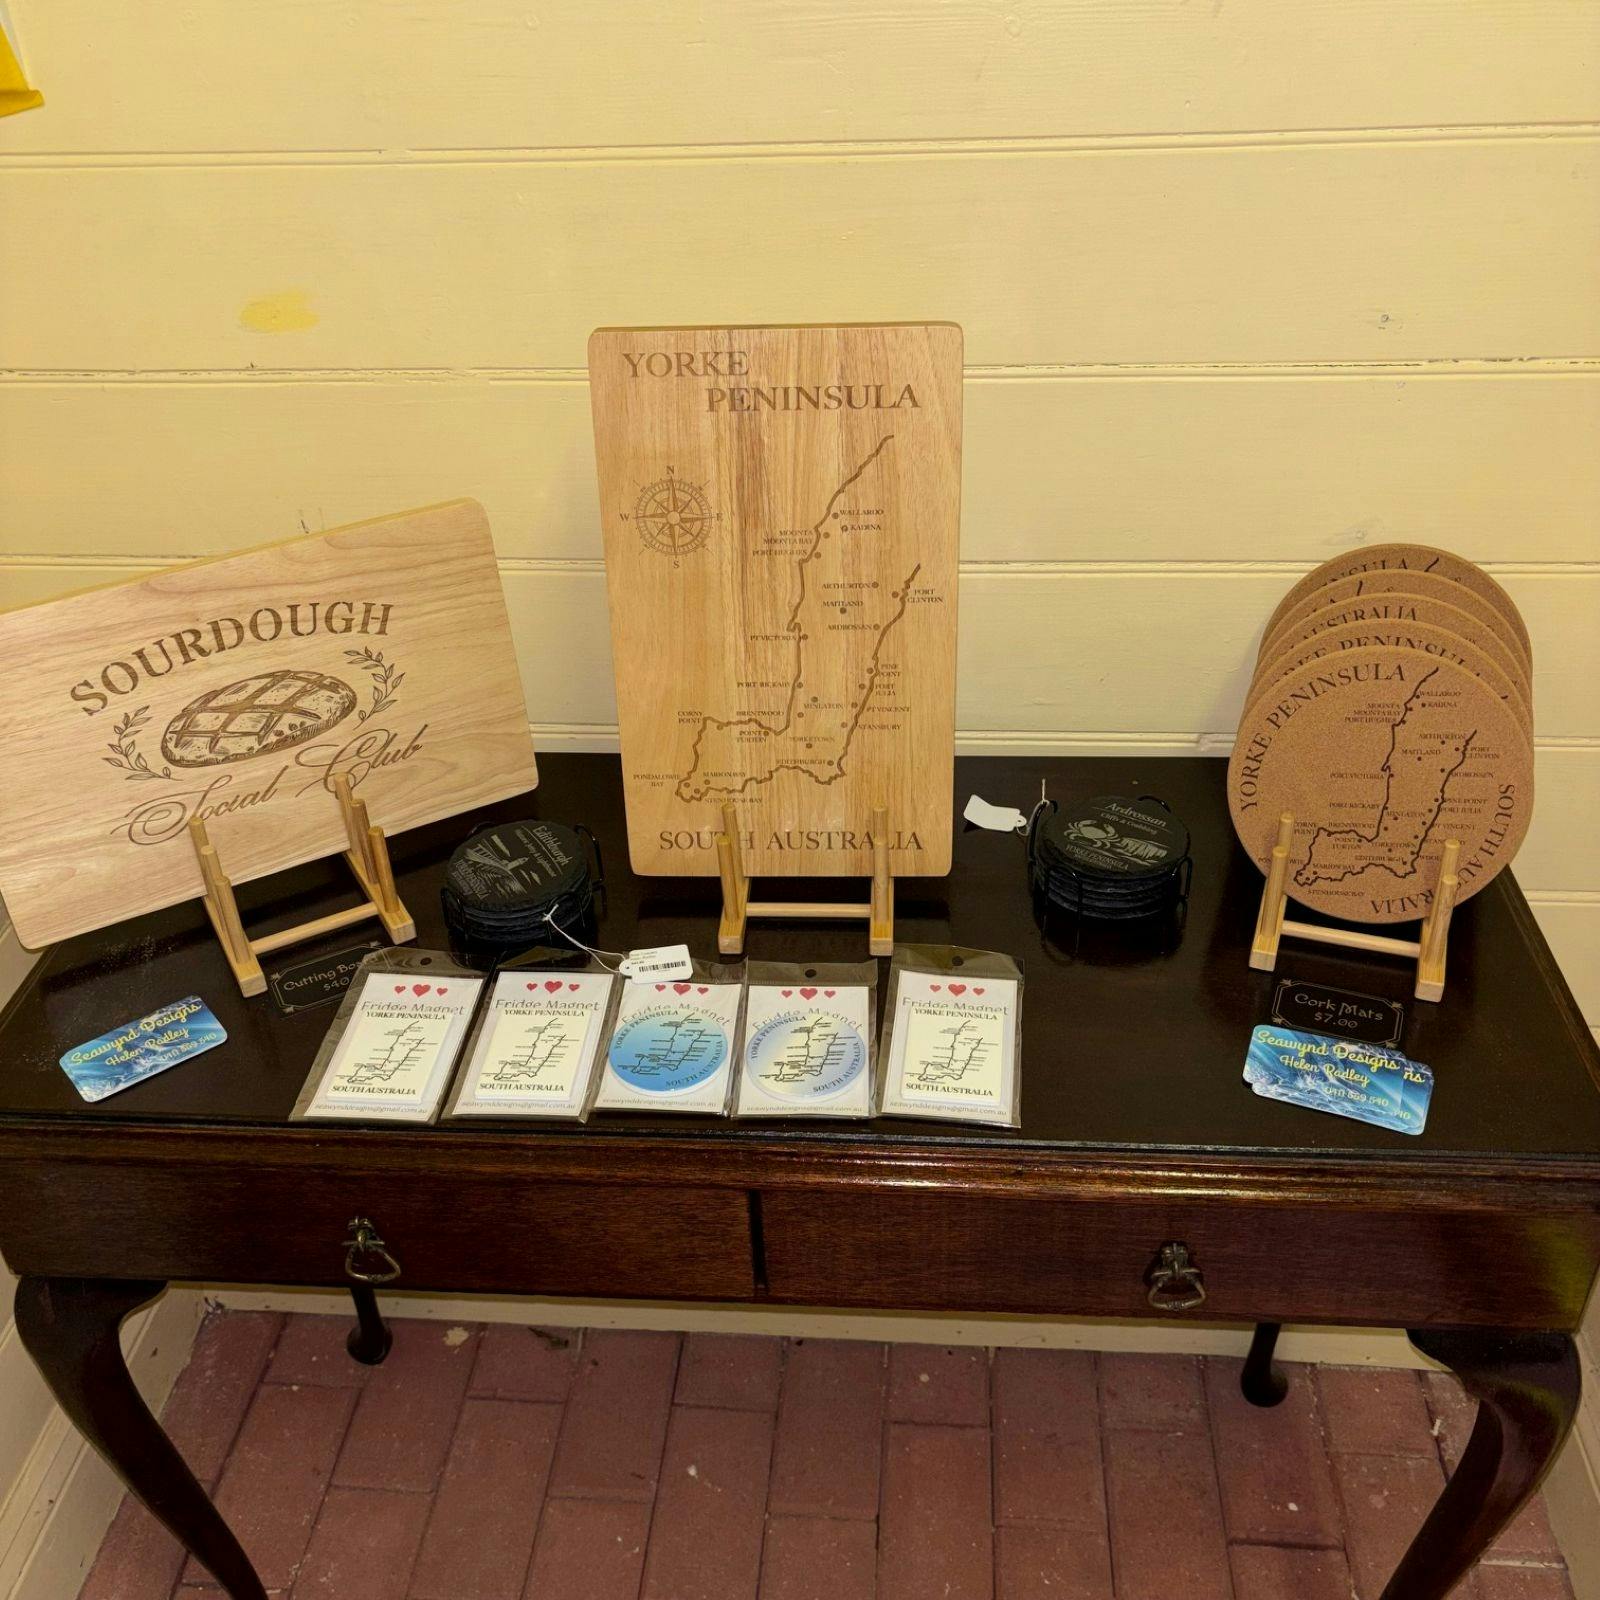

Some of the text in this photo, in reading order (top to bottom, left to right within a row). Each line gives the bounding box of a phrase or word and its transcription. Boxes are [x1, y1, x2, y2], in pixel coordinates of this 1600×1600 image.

[622, 350, 749, 378] YORKE
[705, 383, 921, 413] PENINSULA
[666, 465, 674, 475] N
[619, 512, 630, 521] W
[839, 508, 884, 516] WALLAROO
[673, 560, 680, 569] S
[70, 601, 394, 717] SOURDOUGH
[1241, 732, 1273, 812] YORKE
[1267, 662, 1406, 730] PENINSULA
[111, 723, 430, 846] Social Club
[1106, 803, 1167, 828] Ardrossan
[1480, 783, 1516, 857] SOUTH
[660, 830, 923, 851] SOUH AUSTRAIA
[283, 970, 336, 990] Cutting
[396, 1012, 446, 1020] PENINSULA
[504, 1008, 585, 1017] YORKE PENINSULA
[914, 1007, 998, 1020] YORKE PENINSULA
[1295, 993, 1384, 1022] Cork Mats
[1314, 1012, 1358, 1029] $7.00
[70, 1003, 202, 1066] Seawynd Designs
[105, 1028, 189, 1067] Helen Radley
[1257, 1029, 1400, 1073] Seawynd Designs
[1279, 1055, 1370, 1089] Helen Radley
[333, 1085, 416, 1095] SOUTH AUSTRALIA
[480, 1082, 565, 1092] SOUTH AUSTRALIA
[905, 1082, 993, 1096] SOUTH AUSTRALIA
